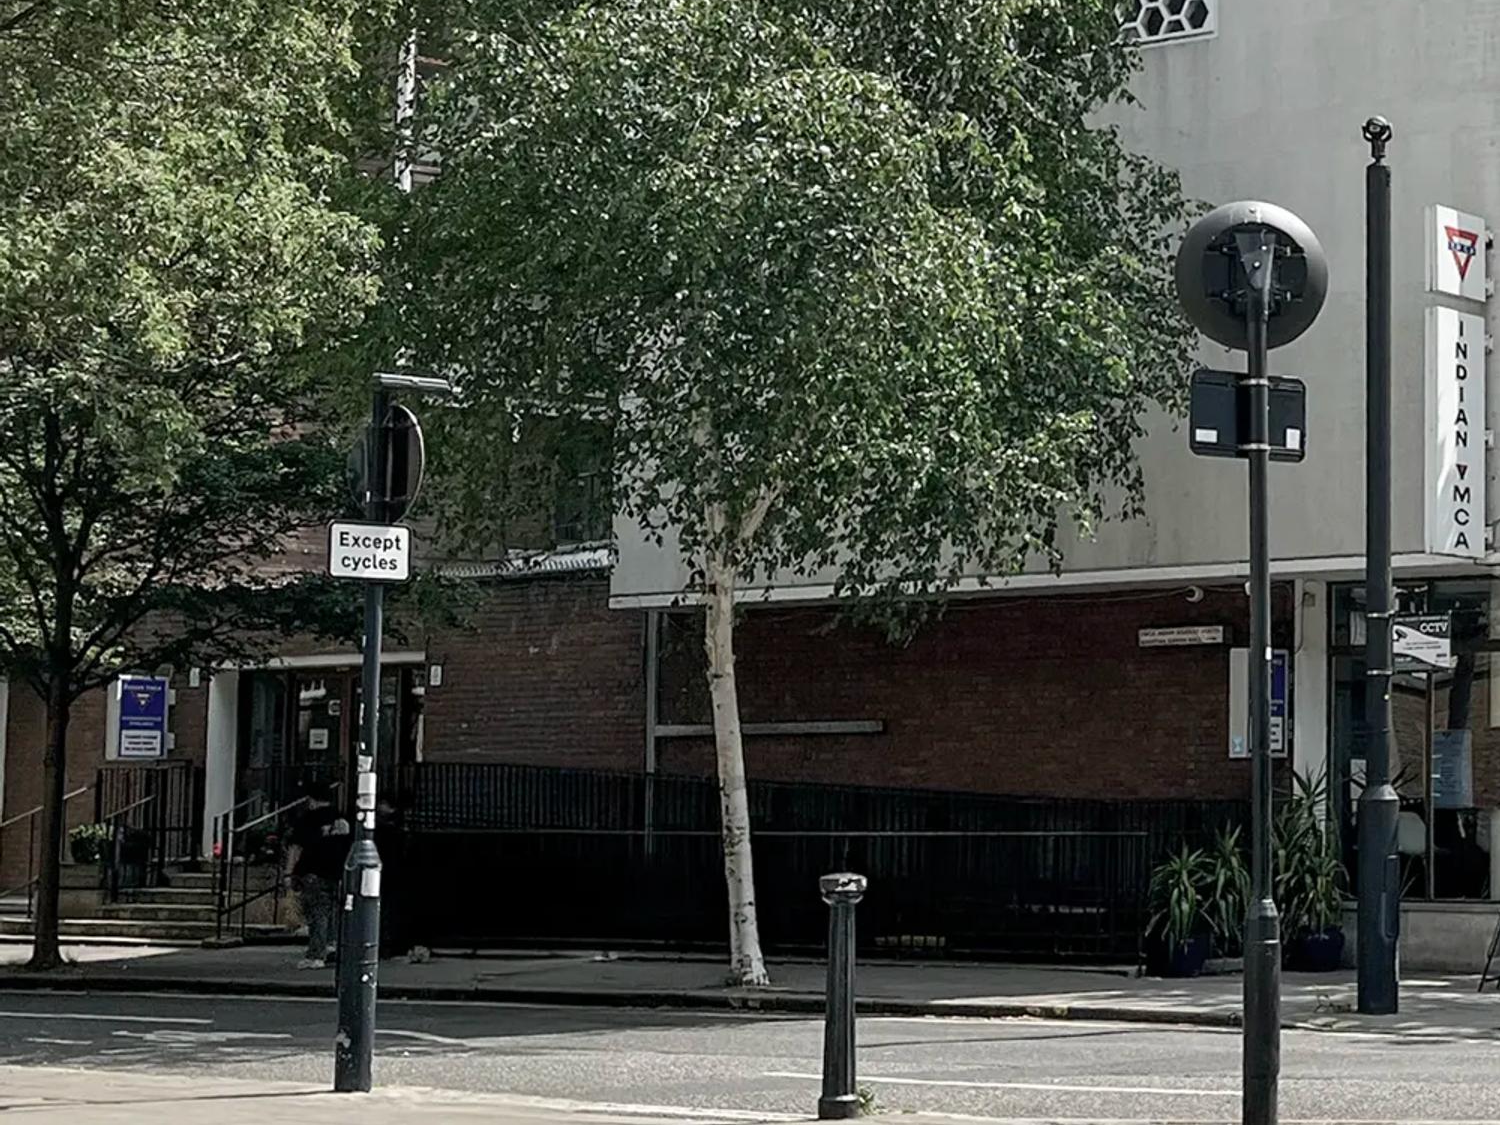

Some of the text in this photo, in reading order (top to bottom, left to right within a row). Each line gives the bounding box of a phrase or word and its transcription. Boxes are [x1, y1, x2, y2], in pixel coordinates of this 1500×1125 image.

[1453, 320, 1471, 550] INDIAN YMCA
[339, 531, 402, 552] Except
[341, 553, 398, 571] cycles
[1420, 621, 1449, 633] CCTV
